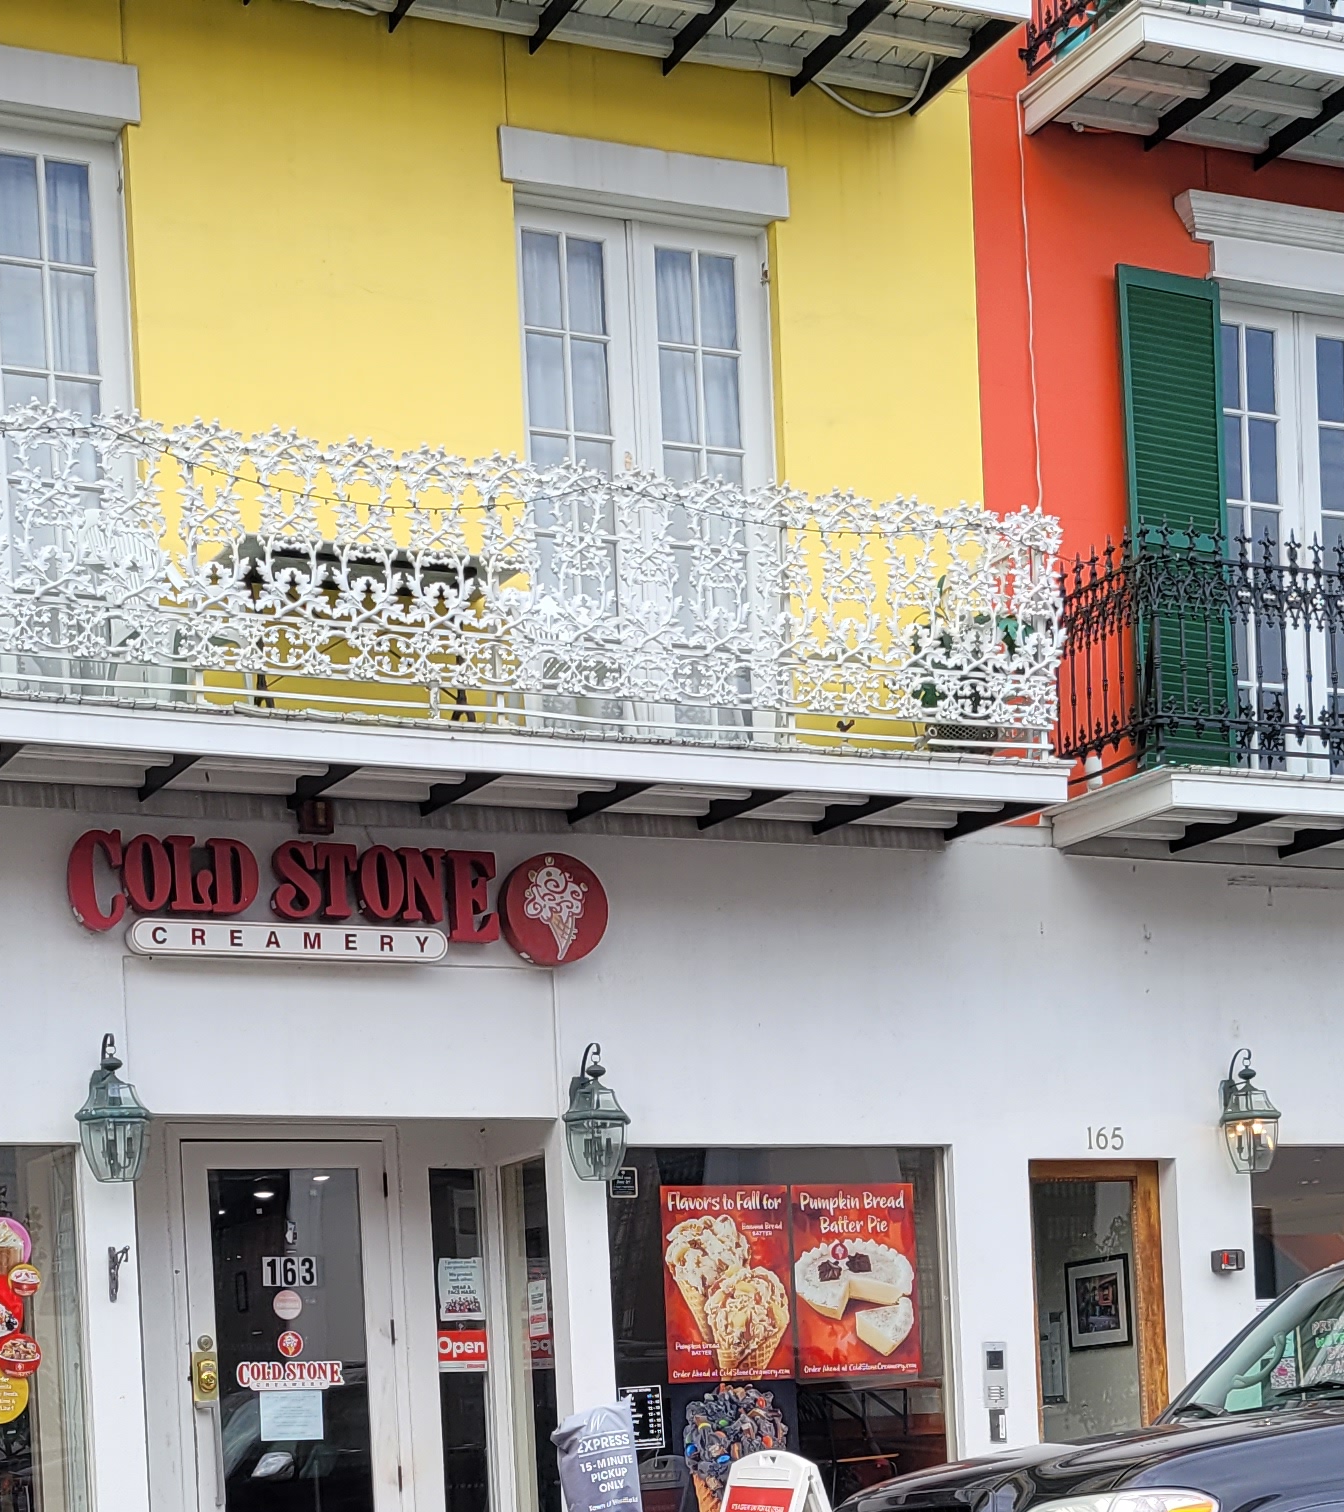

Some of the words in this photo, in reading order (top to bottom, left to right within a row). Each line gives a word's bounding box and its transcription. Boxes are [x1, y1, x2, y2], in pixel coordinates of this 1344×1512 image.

[67, 829, 259, 932] COLD
[271, 840, 499, 944] STONE
[151, 926, 429, 953] CREAMERY
[1086, 1126, 1124, 1151] 165
[667, 1191, 720, 1211] Flavors
[722, 1194, 734, 1210] to
[736, 1190, 760, 1210] Fall
[762, 1194, 781, 1210] for
[800, 1190, 859, 1216] Pumpkin
[863, 1189, 904, 1209] Bread
[764, 1221, 783, 1230] Bread
[819, 1215, 864, 1234] Batter
[867, 1215, 888, 1233] Pie
[267, 1257, 315, 1285] 163
[439, 1337, 485, 1358] Open
[238, 1363, 282, 1385] COLD
[286, 1362, 342, 1383] STONE
[673, 1370, 690, 1379] Order
[691, 1368, 711, 1377] Ahead
[804, 1365, 821, 1374] Order
[822, 1364, 840, 1373] Ahead
[577, 1434, 629, 1454] EXPRESS
[579, 1454, 633, 1473] 15-MINUTE
[591, 1467, 628, 1483] PICKUP
[599, 1479, 624, 1493] ONLY
